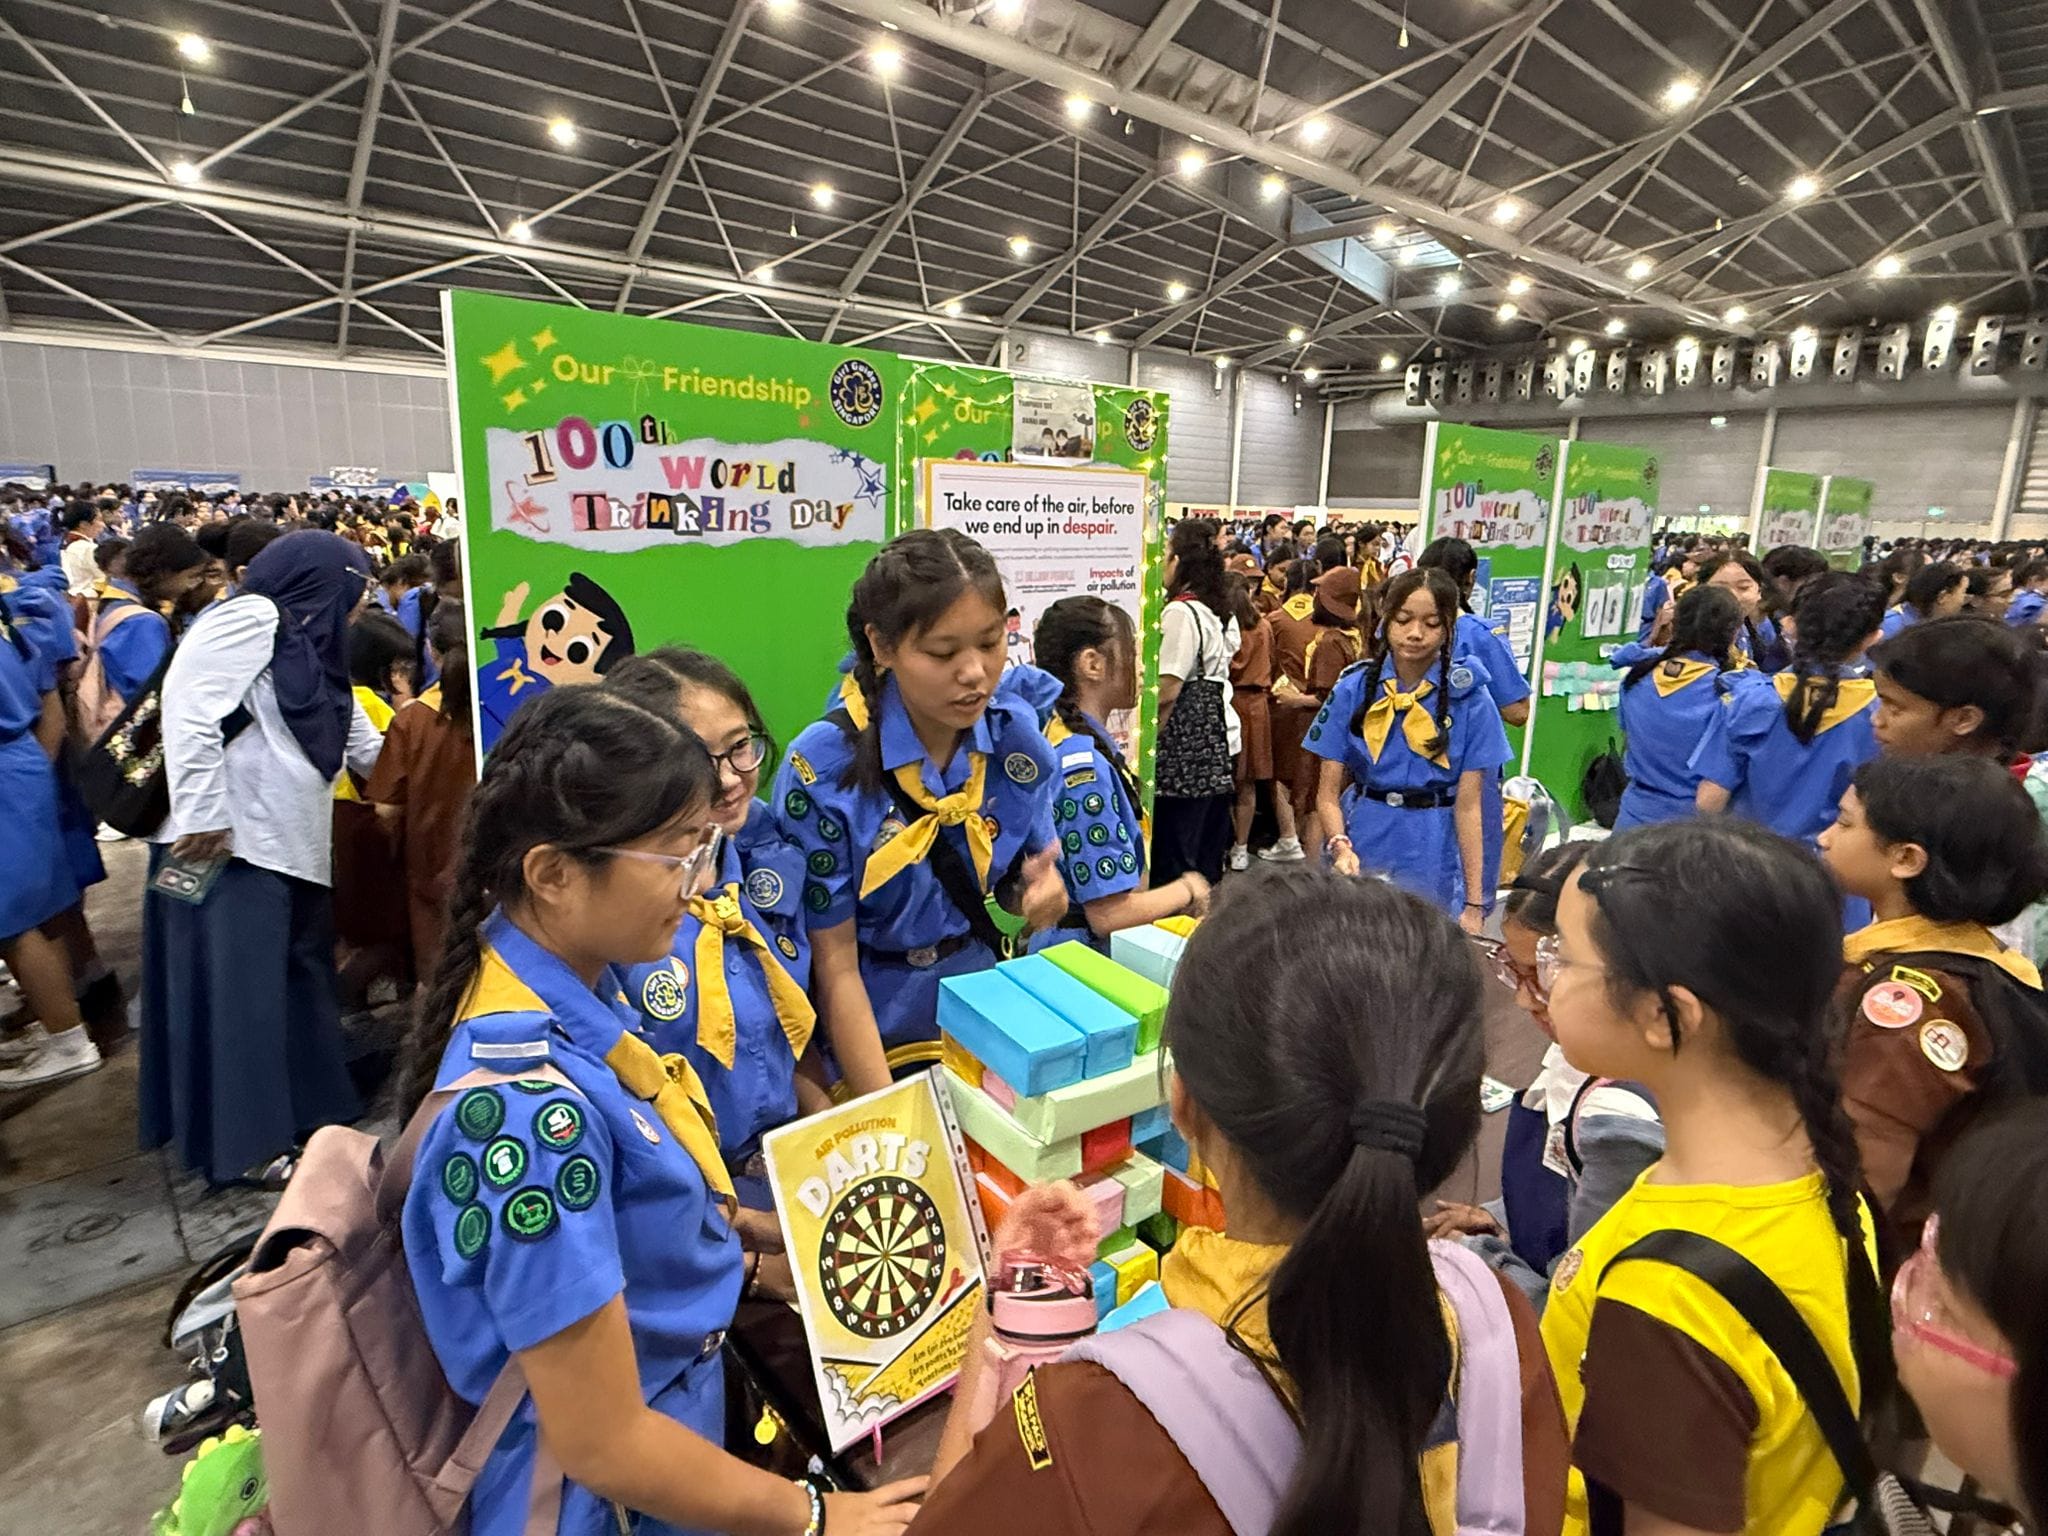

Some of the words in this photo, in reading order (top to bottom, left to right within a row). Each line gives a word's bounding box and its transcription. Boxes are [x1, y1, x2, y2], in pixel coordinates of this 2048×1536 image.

[1015, 343, 1025, 362] 2
[553, 354, 615, 385] Our
[662, 367, 812, 409] Friendship
[851, 361, 879, 390] Guides
[833, 398, 880, 425] SINGAPORE
[954, 401, 991, 424] Our
[524, 414, 678, 485] 100th
[944, 491, 982, 512] Take
[985, 499, 1020, 512] care
[1024, 494, 1040, 512] of
[1042, 495, 1064, 513] the
[1067, 497, 1089, 516] air,
[1092, 496, 1135, 515] before
[571, 491, 772, 535] Thinking
[790, 498, 854, 531] Day
[965, 521, 990, 534] we
[993, 515, 1022, 534] end
[1025, 521, 1044, 539] up
[1047, 517, 1060, 534] in
[1062, 516, 1118, 539] despair.
[1089, 568, 1124, 580] Impacts
[1125, 565, 1135, 577] of
[1086, 580, 1100, 592] air
[1100, 579, 1136, 594] pollution
[815, 1138, 834, 1160] AIR
[834, 1117, 897, 1145] POLLUTION
[795, 1131, 932, 1220] DARTS
[860, 1183, 875, 1198] 20
[882, 1181, 888, 1191] 1
[897, 1182, 909, 1194] 18
[848, 1196, 857, 1208] 5
[834, 1211, 846, 1223] 12
[924, 1207, 936, 1220] 13
[931, 1223, 941, 1236] 6
[825, 1231, 836, 1244] 9
[933, 1244, 945, 1256] 10
[821, 1256, 834, 1270] 14
[931, 1265, 942, 1278] 15
[825, 1277, 836, 1290] 11
[923, 1286, 932, 1299] 2
[833, 1296, 844, 1311] 8
[910, 1303, 921, 1317] 17
[846, 1313, 859, 1326] 16
[897, 1315, 906, 1328] 3
[878, 1320, 890, 1335] 19
